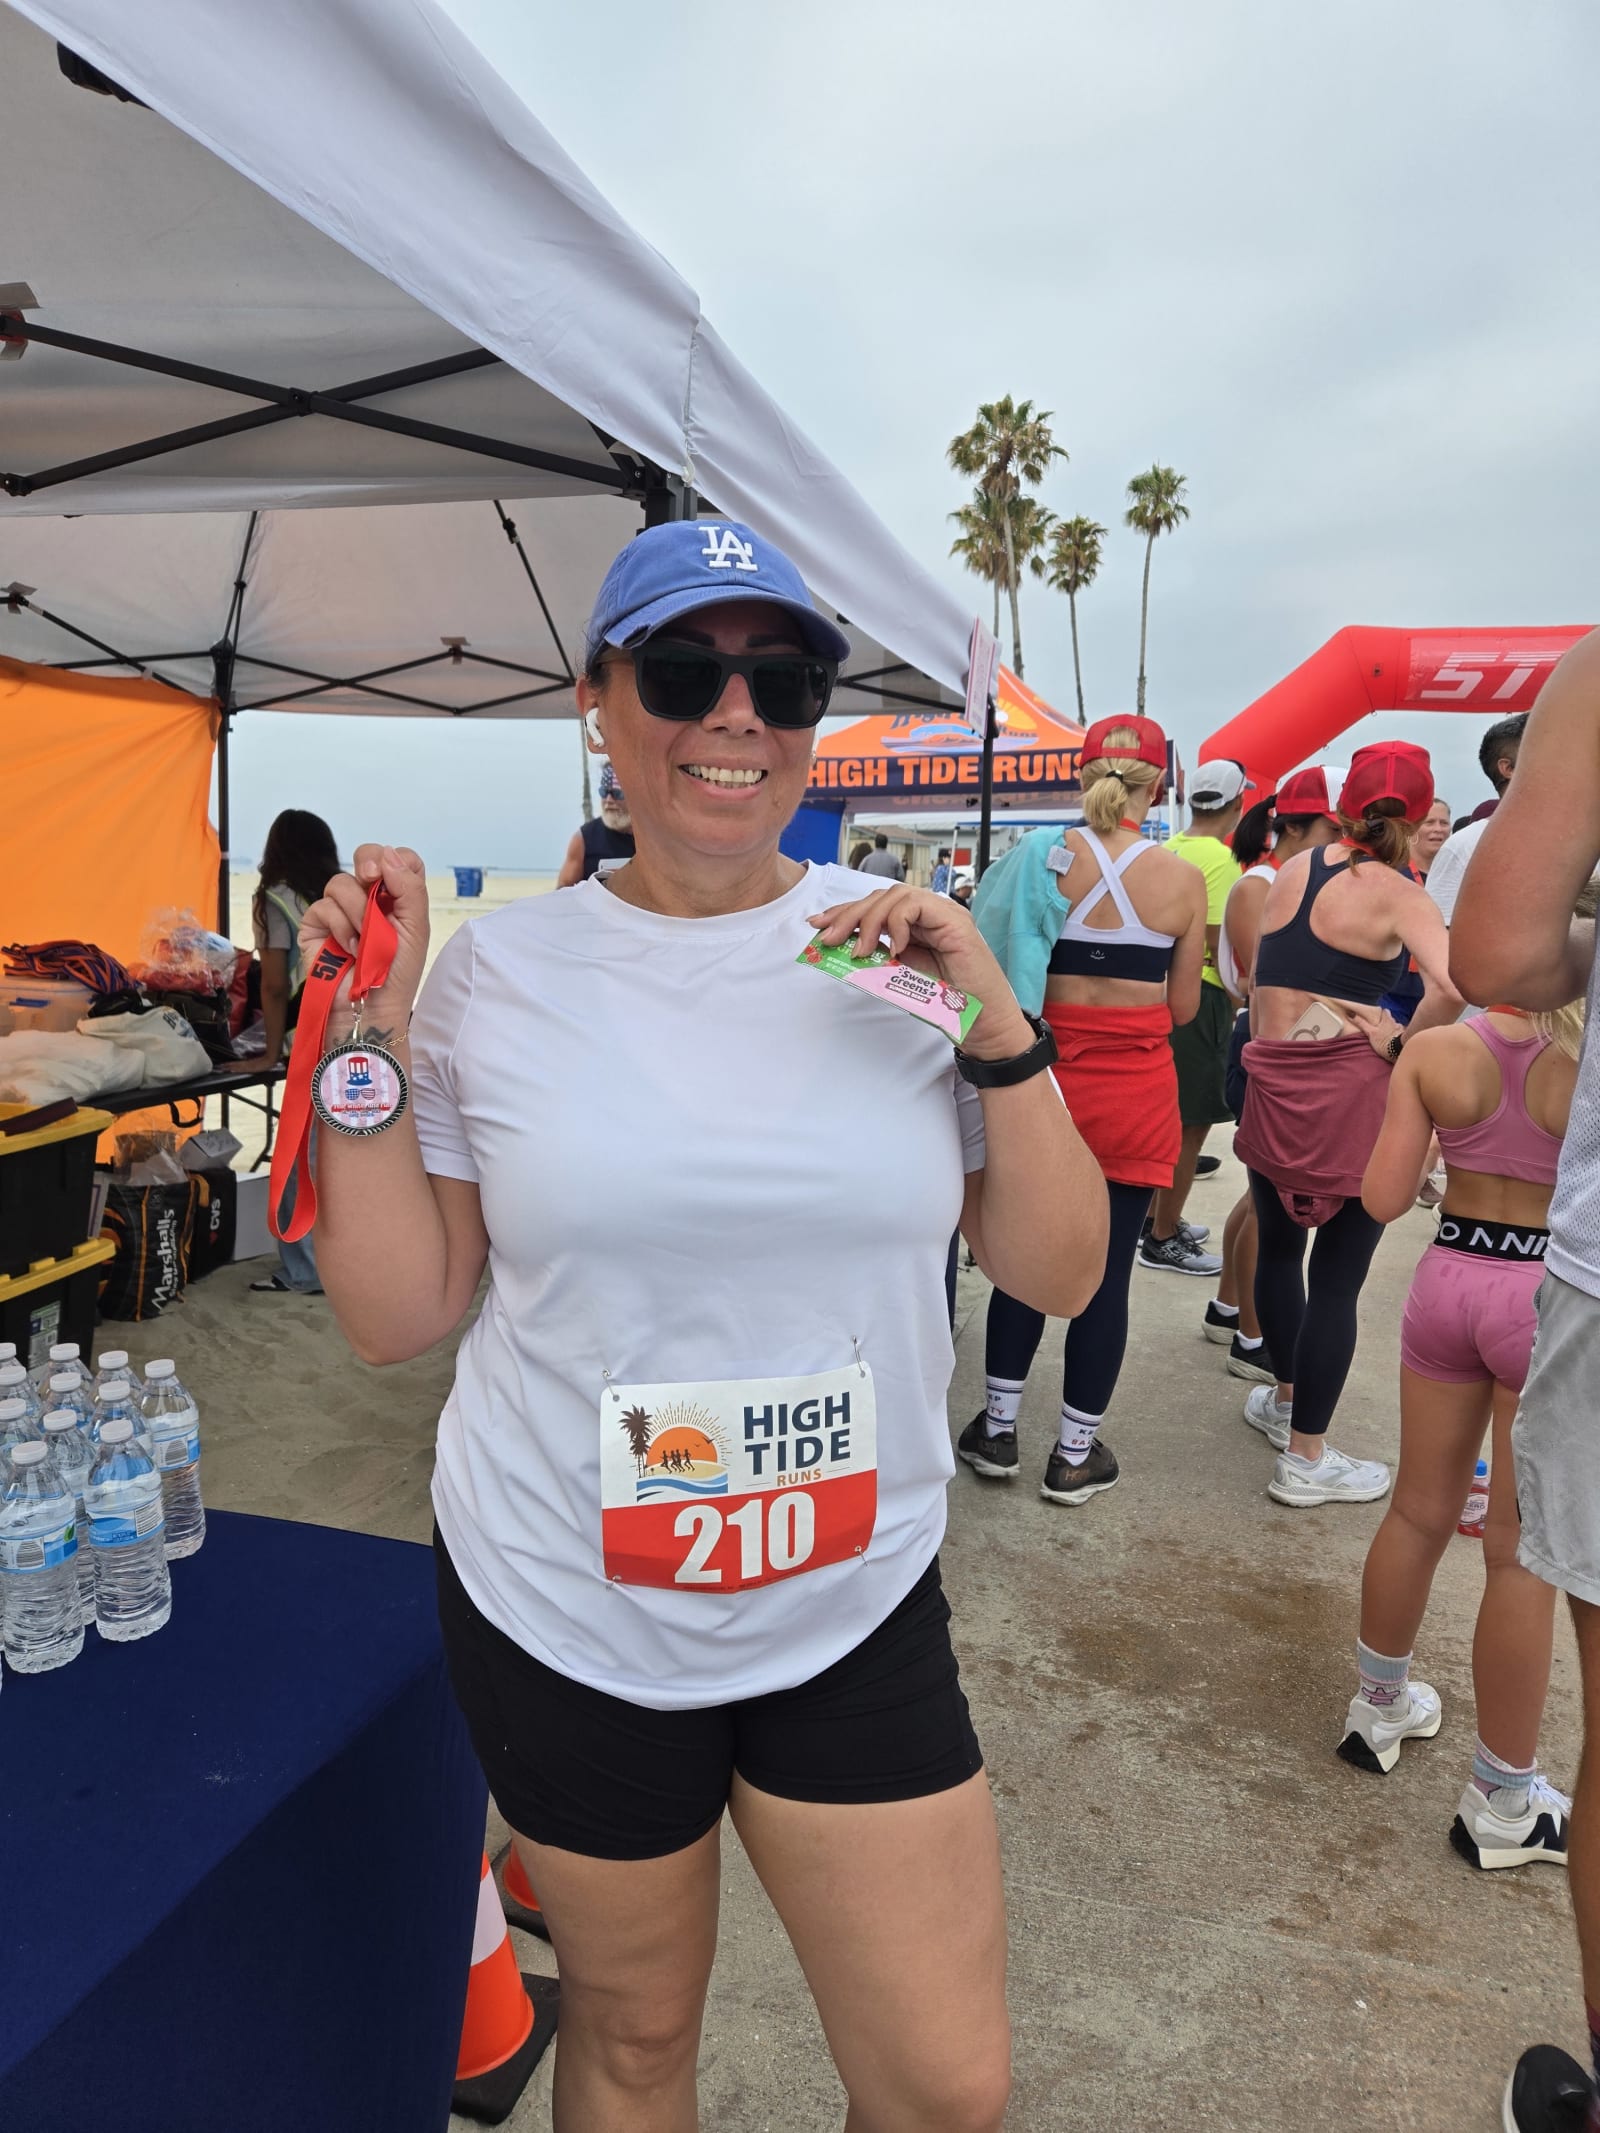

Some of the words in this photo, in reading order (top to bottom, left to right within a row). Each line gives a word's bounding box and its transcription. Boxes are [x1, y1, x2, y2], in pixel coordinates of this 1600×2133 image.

[698, 526, 758, 571] LA
[806, 758, 888, 788] HIGH
[897, 756, 980, 785] TIDE
[311, 948, 348, 981] 5K
[901, 970, 937, 989] Sweet
[891, 976, 929, 995] Greens
[210, 1198, 221, 1230] CVS
[152, 1209, 175, 1310] Marshalls
[743, 1391, 850, 1440] HIGH
[745, 1428, 851, 1476] TIDE
[776, 1468, 823, 1487] RUNS
[674, 1491, 815, 1584] 210
